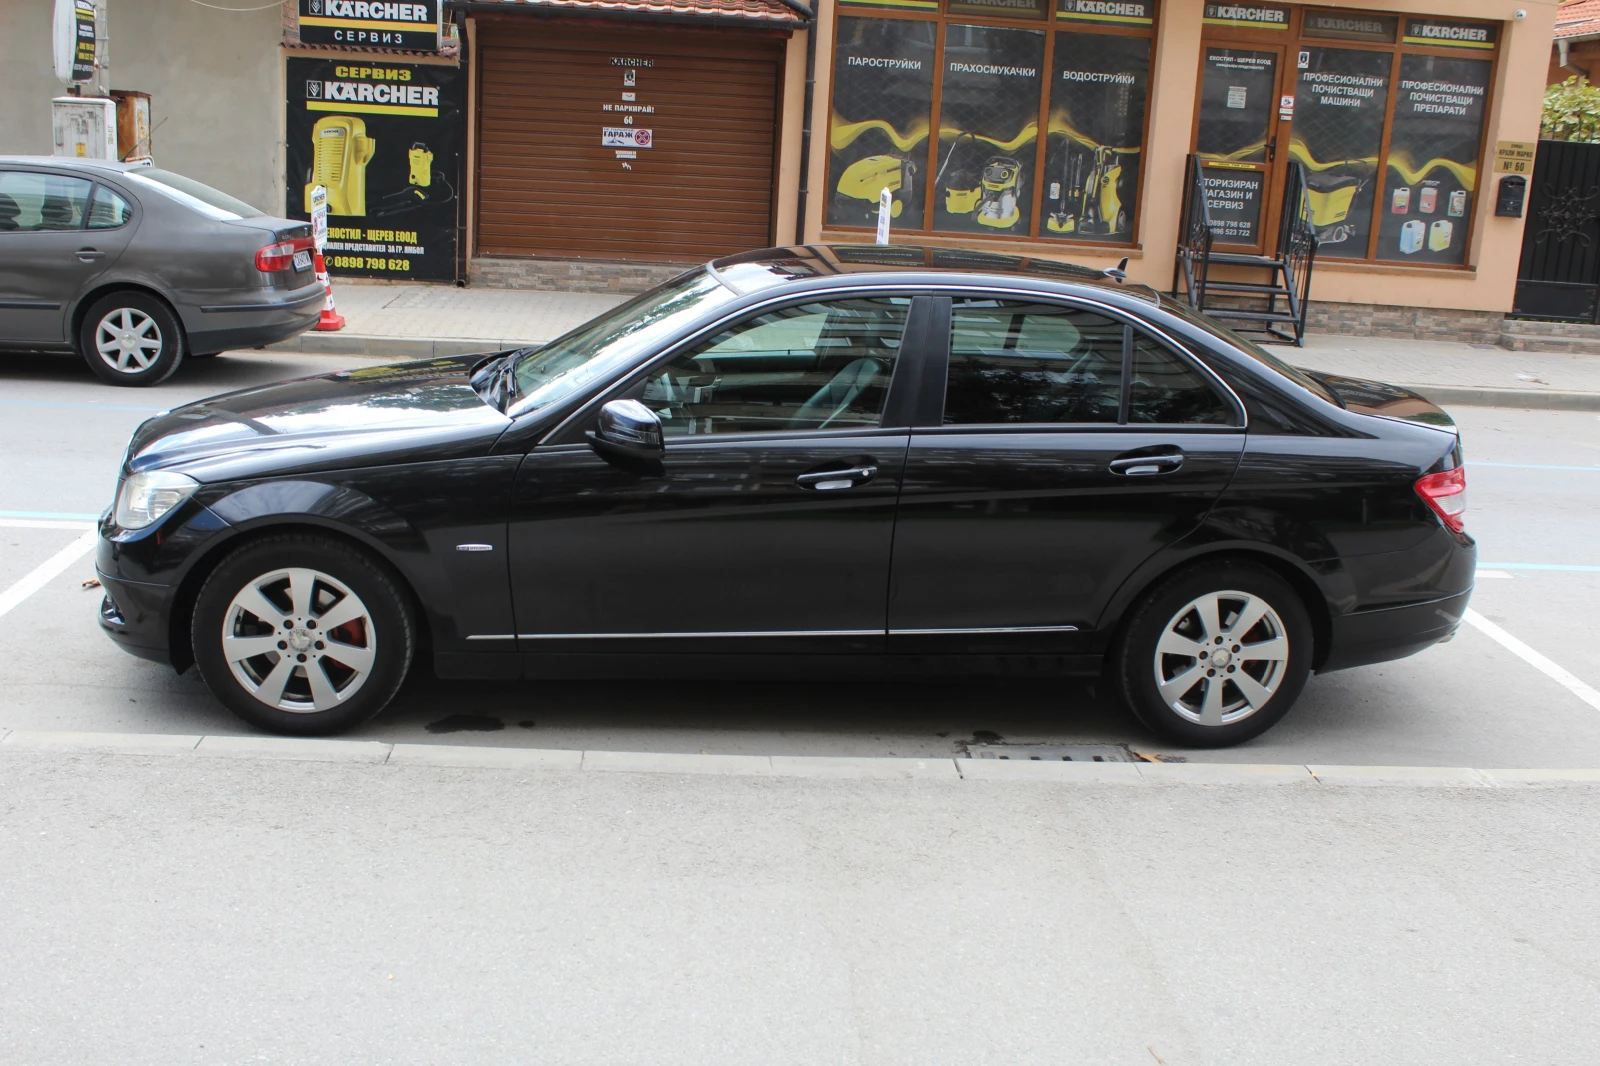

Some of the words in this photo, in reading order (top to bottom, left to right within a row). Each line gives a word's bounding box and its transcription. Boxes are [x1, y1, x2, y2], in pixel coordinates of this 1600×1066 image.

[325, 0, 428, 21] KÄRCHER
[1076, 0, 1145, 16] KÄRCHER
[1217, 6, 1284, 22] KÄRCHER
[1317, 17, 1383, 32] KÄRCHER
[334, 30, 403, 44] СЕРВИЗ
[1422, 25, 1487, 41] KÄRCHER
[848, 56, 921, 70] ПАРОСТРУЙКИ
[950, 63, 1036, 77] ПРАХОСМУКАЧКИ
[335, 66, 412, 81] СЕРВИЗ
[1063, 70, 1135, 84] ВОДОСТРУЙКИ
[1303, 72, 1383, 87] ПРОФЕСИОНАЛНИ
[324, 81, 439, 105] KÄRCHER
[1312, 84, 1374, 98] ПОЧИСТВАЩИ
[1402, 80, 1484, 95] ПРОФЕСИОНАЛНИ
[1320, 96, 1361, 107] МАШИНИ
[1409, 92, 1473, 105] ПОЧИСТВАЩИ
[1414, 104, 1466, 115] ПРЕПАРАТИ
[624, 116, 633, 124] 60
[1199, 178, 1258, 189] ТОРИЗИРАН
[1245, 191, 1252, 200] И
[1207, 200, 1244, 209] СЕРВИЗ
[367, 229, 394, 242] ЩЕРЕВ
[395, 231, 418, 244] ЕООД
[334, 256, 364, 268] 0898
[365, 257, 386, 269] 798
[388, 259, 410, 271] 628
